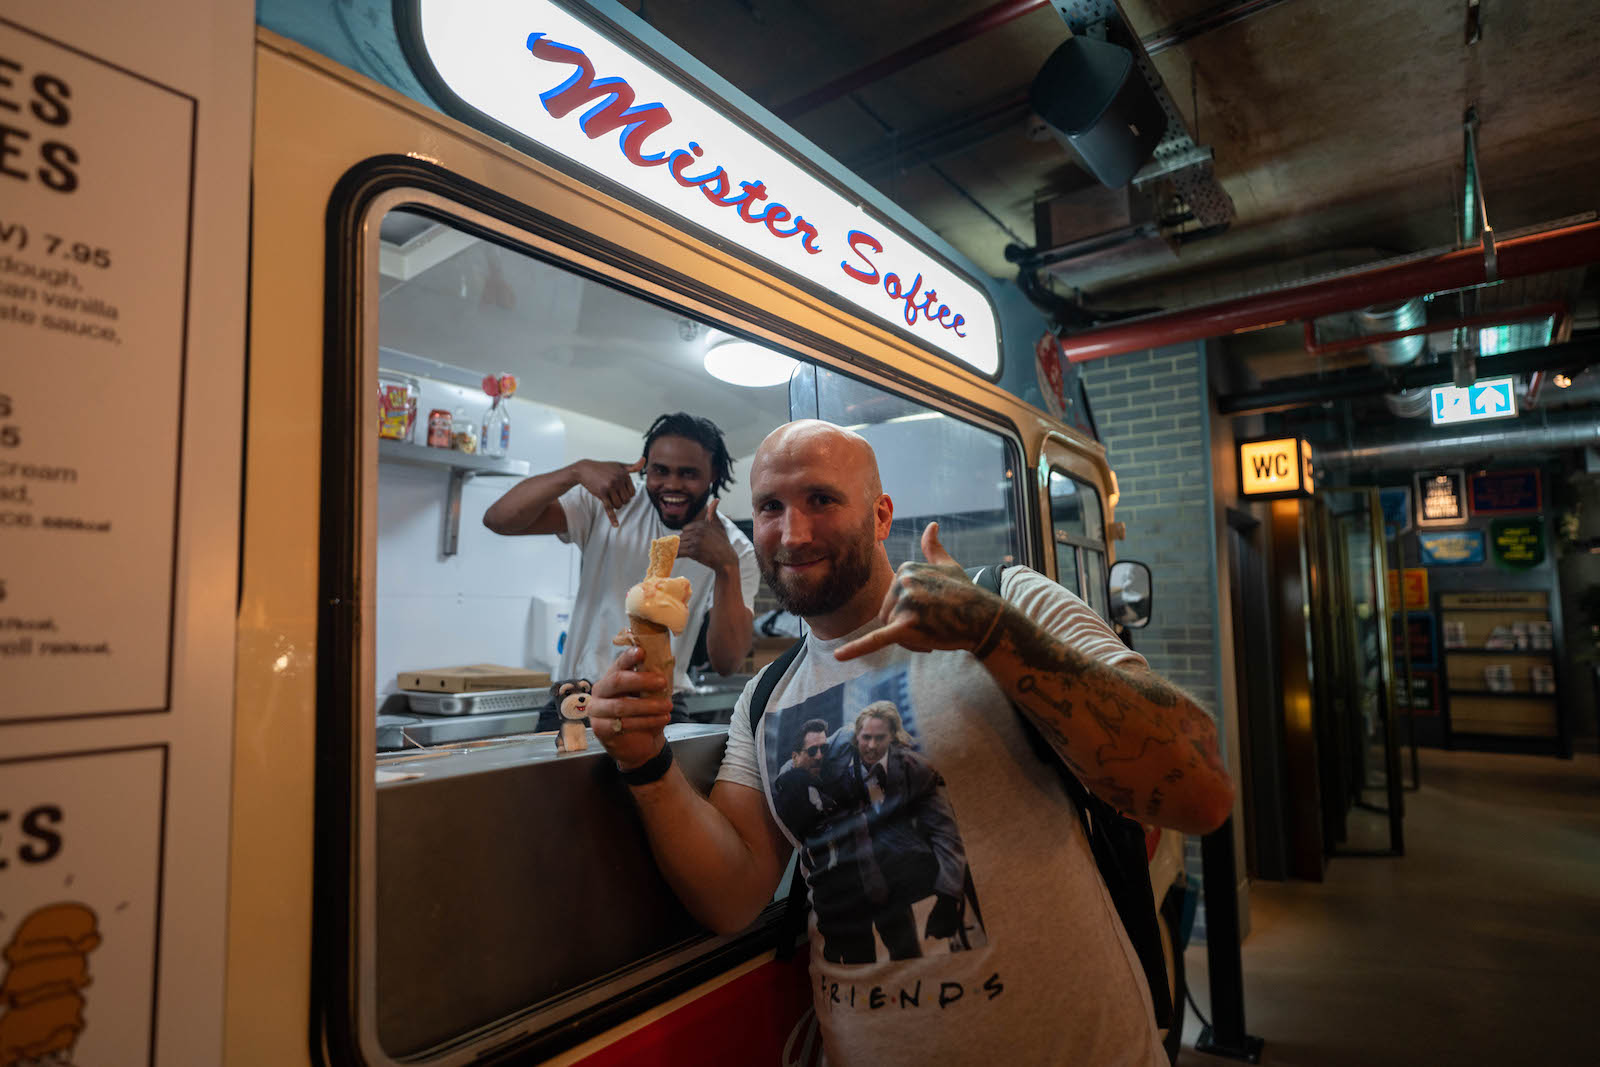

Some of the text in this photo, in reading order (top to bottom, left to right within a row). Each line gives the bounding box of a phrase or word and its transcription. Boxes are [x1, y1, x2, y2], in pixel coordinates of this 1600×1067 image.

[0, 124, 80, 193] ES
[526, 32, 968, 338] Mister Softee
[43, 231, 112, 269] 7.95
[41, 290, 119, 320] vanilla
[1253, 453, 1288, 478] WC
[0, 804, 64, 871] S
